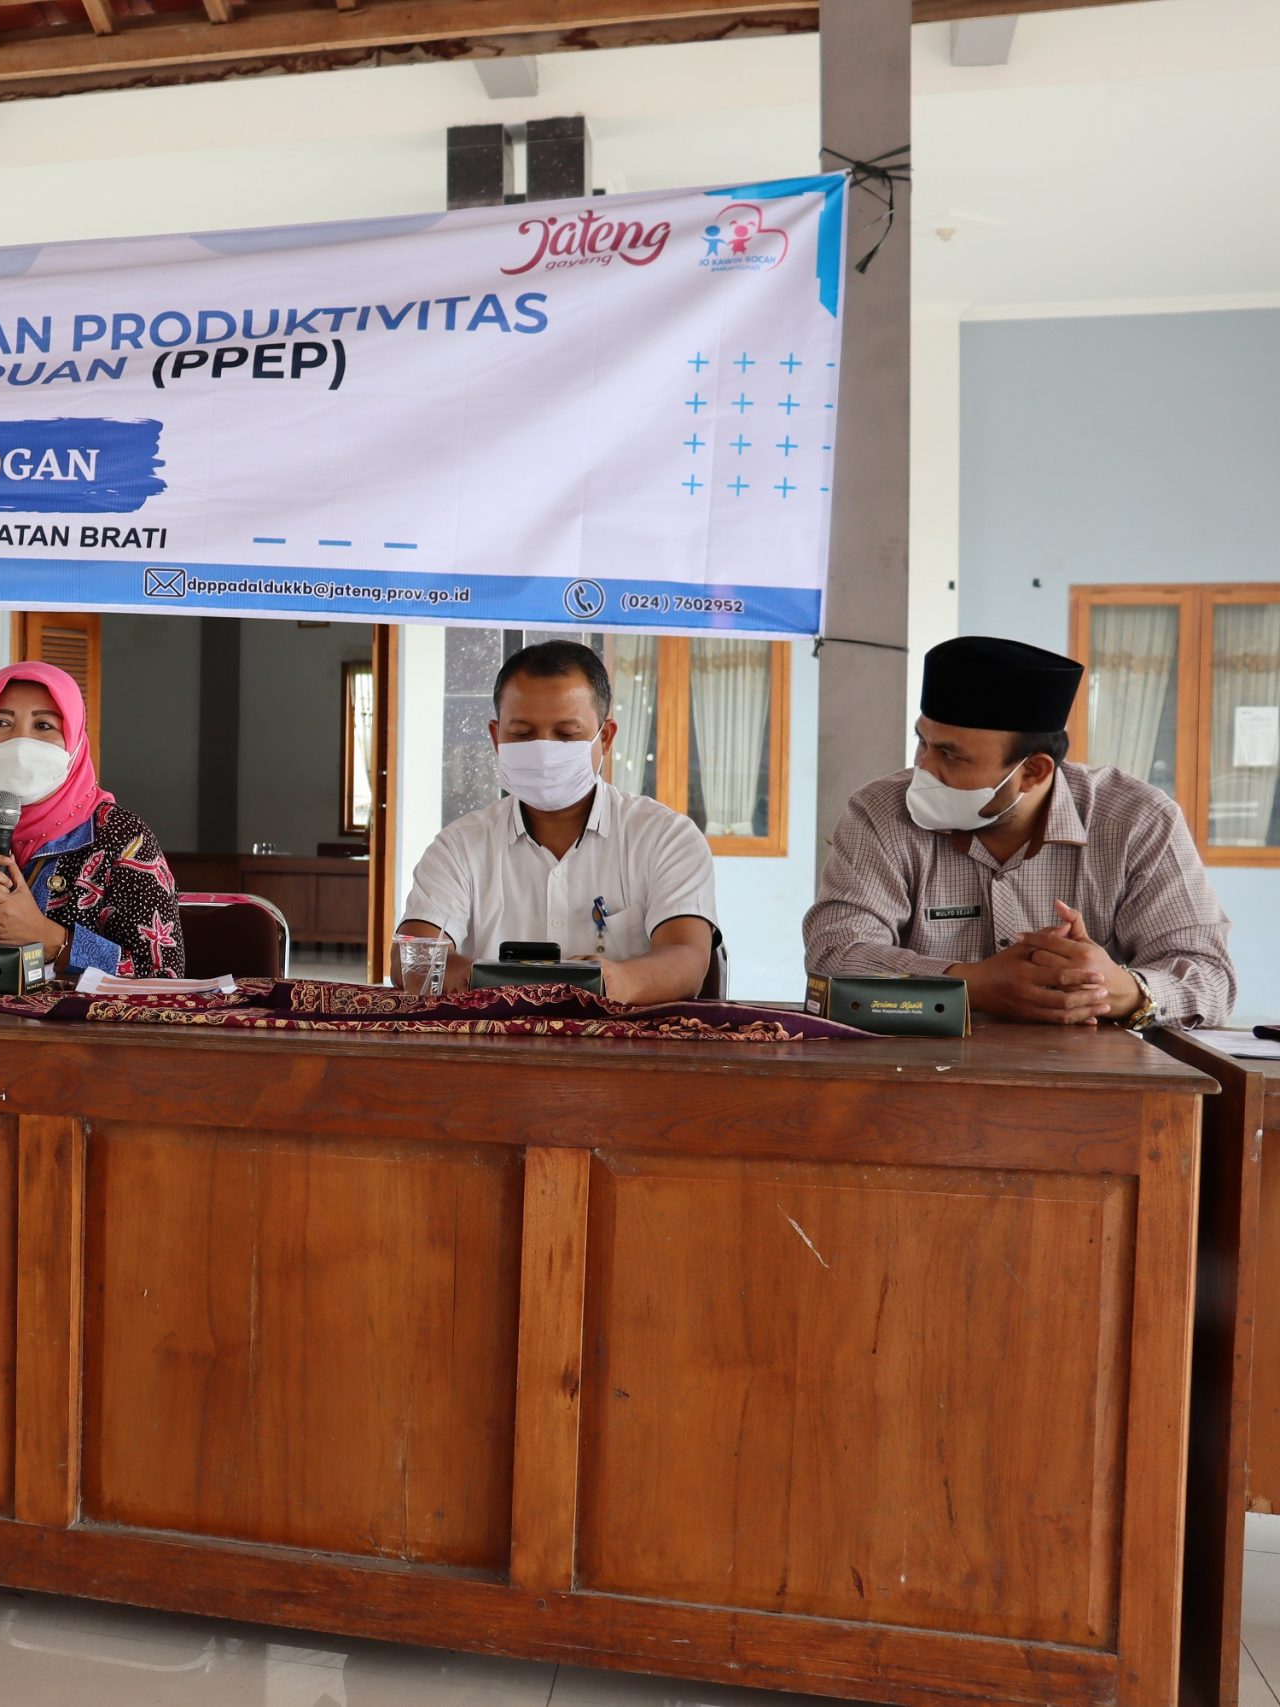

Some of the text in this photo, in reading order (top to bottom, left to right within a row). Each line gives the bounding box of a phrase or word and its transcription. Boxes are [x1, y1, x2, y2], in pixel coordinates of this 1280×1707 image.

[500, 209, 672, 275] Jateng
[545, 253, 613, 272] gayeng
[711, 256, 743, 266] KAWIN
[745, 255, 776, 264] BOCAH
[71, 292, 549, 352] PRODUKTIVITAS
[151, 339, 347, 391] (PPEP)
[79, 526, 169, 550] BRATI
[187, 577, 470, 603] dpppadaldukkb@jateng.prov.go.id
[620, 592, 744, 613] (024) 7602952
[871, 1000, 898, 1009] Terima
